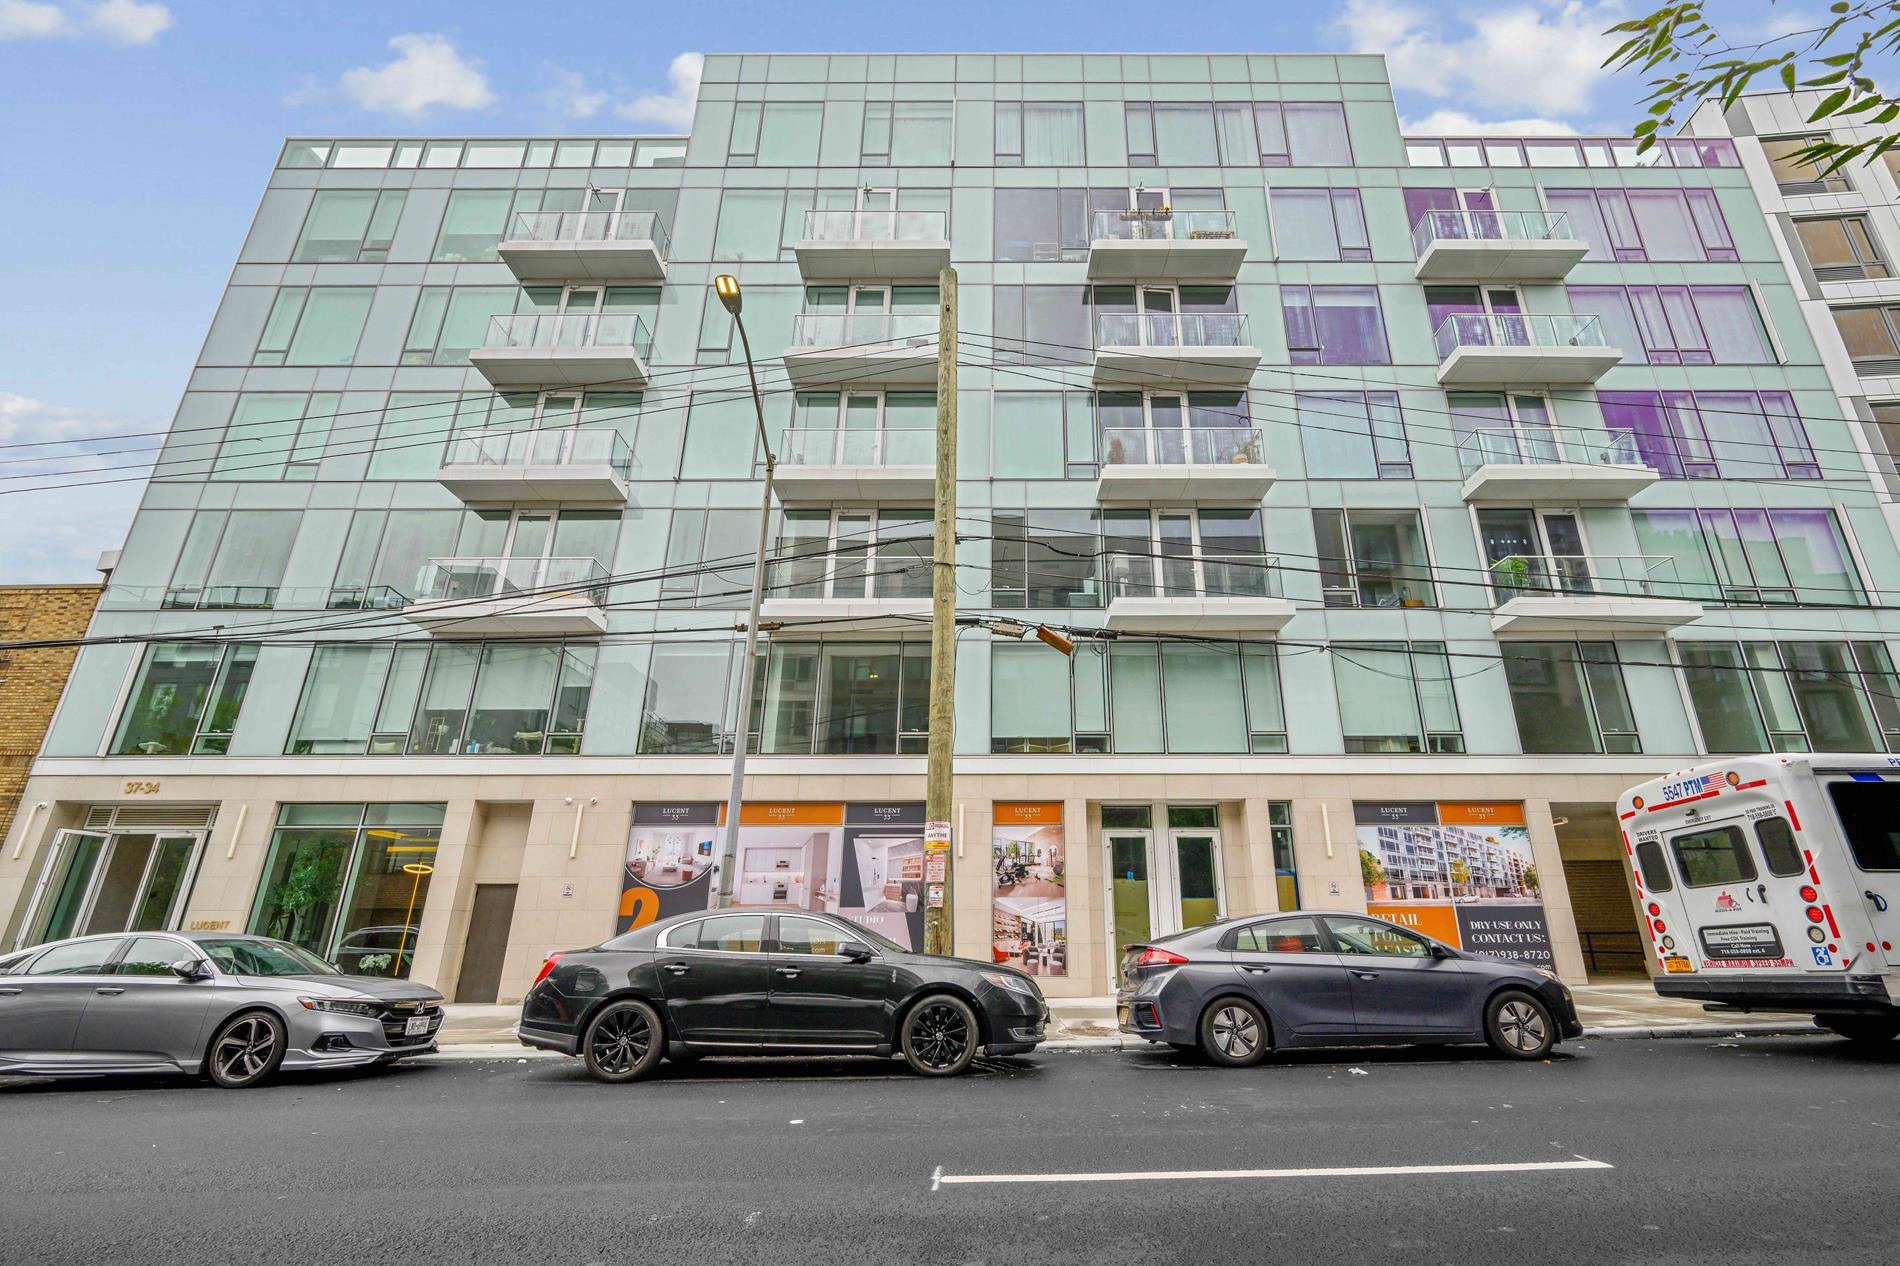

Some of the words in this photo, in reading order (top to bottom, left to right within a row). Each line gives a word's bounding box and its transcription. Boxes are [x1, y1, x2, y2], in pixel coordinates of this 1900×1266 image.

[124, 782, 160, 794] 37-34
[1662, 784, 1683, 802] 5547
[1684, 777, 1704, 796] PTM
[618, 886, 660, 932] 2
[850, 915, 884, 924] TUDIO
[190, 921, 230, 930] LUCENT
[1470, 920, 1513, 929] DRY-USE
[1514, 920, 1541, 929] ONLY
[1472, 934, 1524, 943] CONTACT
[1526, 934, 1546, 943] US:
